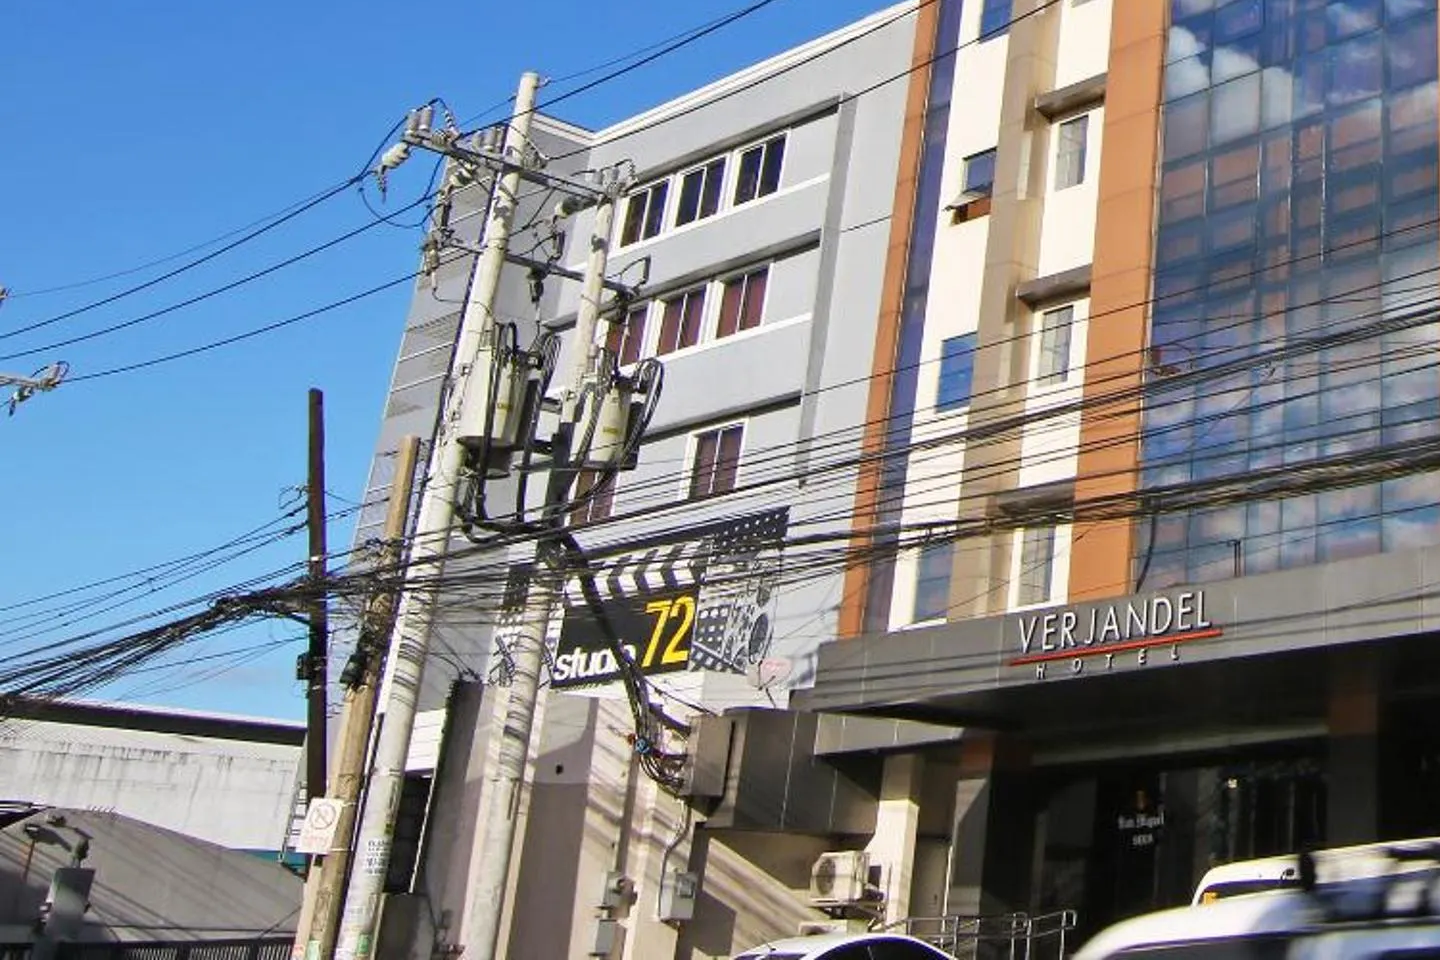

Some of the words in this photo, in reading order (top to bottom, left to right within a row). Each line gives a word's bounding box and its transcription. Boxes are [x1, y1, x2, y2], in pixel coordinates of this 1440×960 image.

[552, 639, 635, 681] stud
[641, 595, 696, 668] 72
[1018, 590, 1212, 654] VERJANDEL
[1035, 644, 1181, 680] HOTEL
